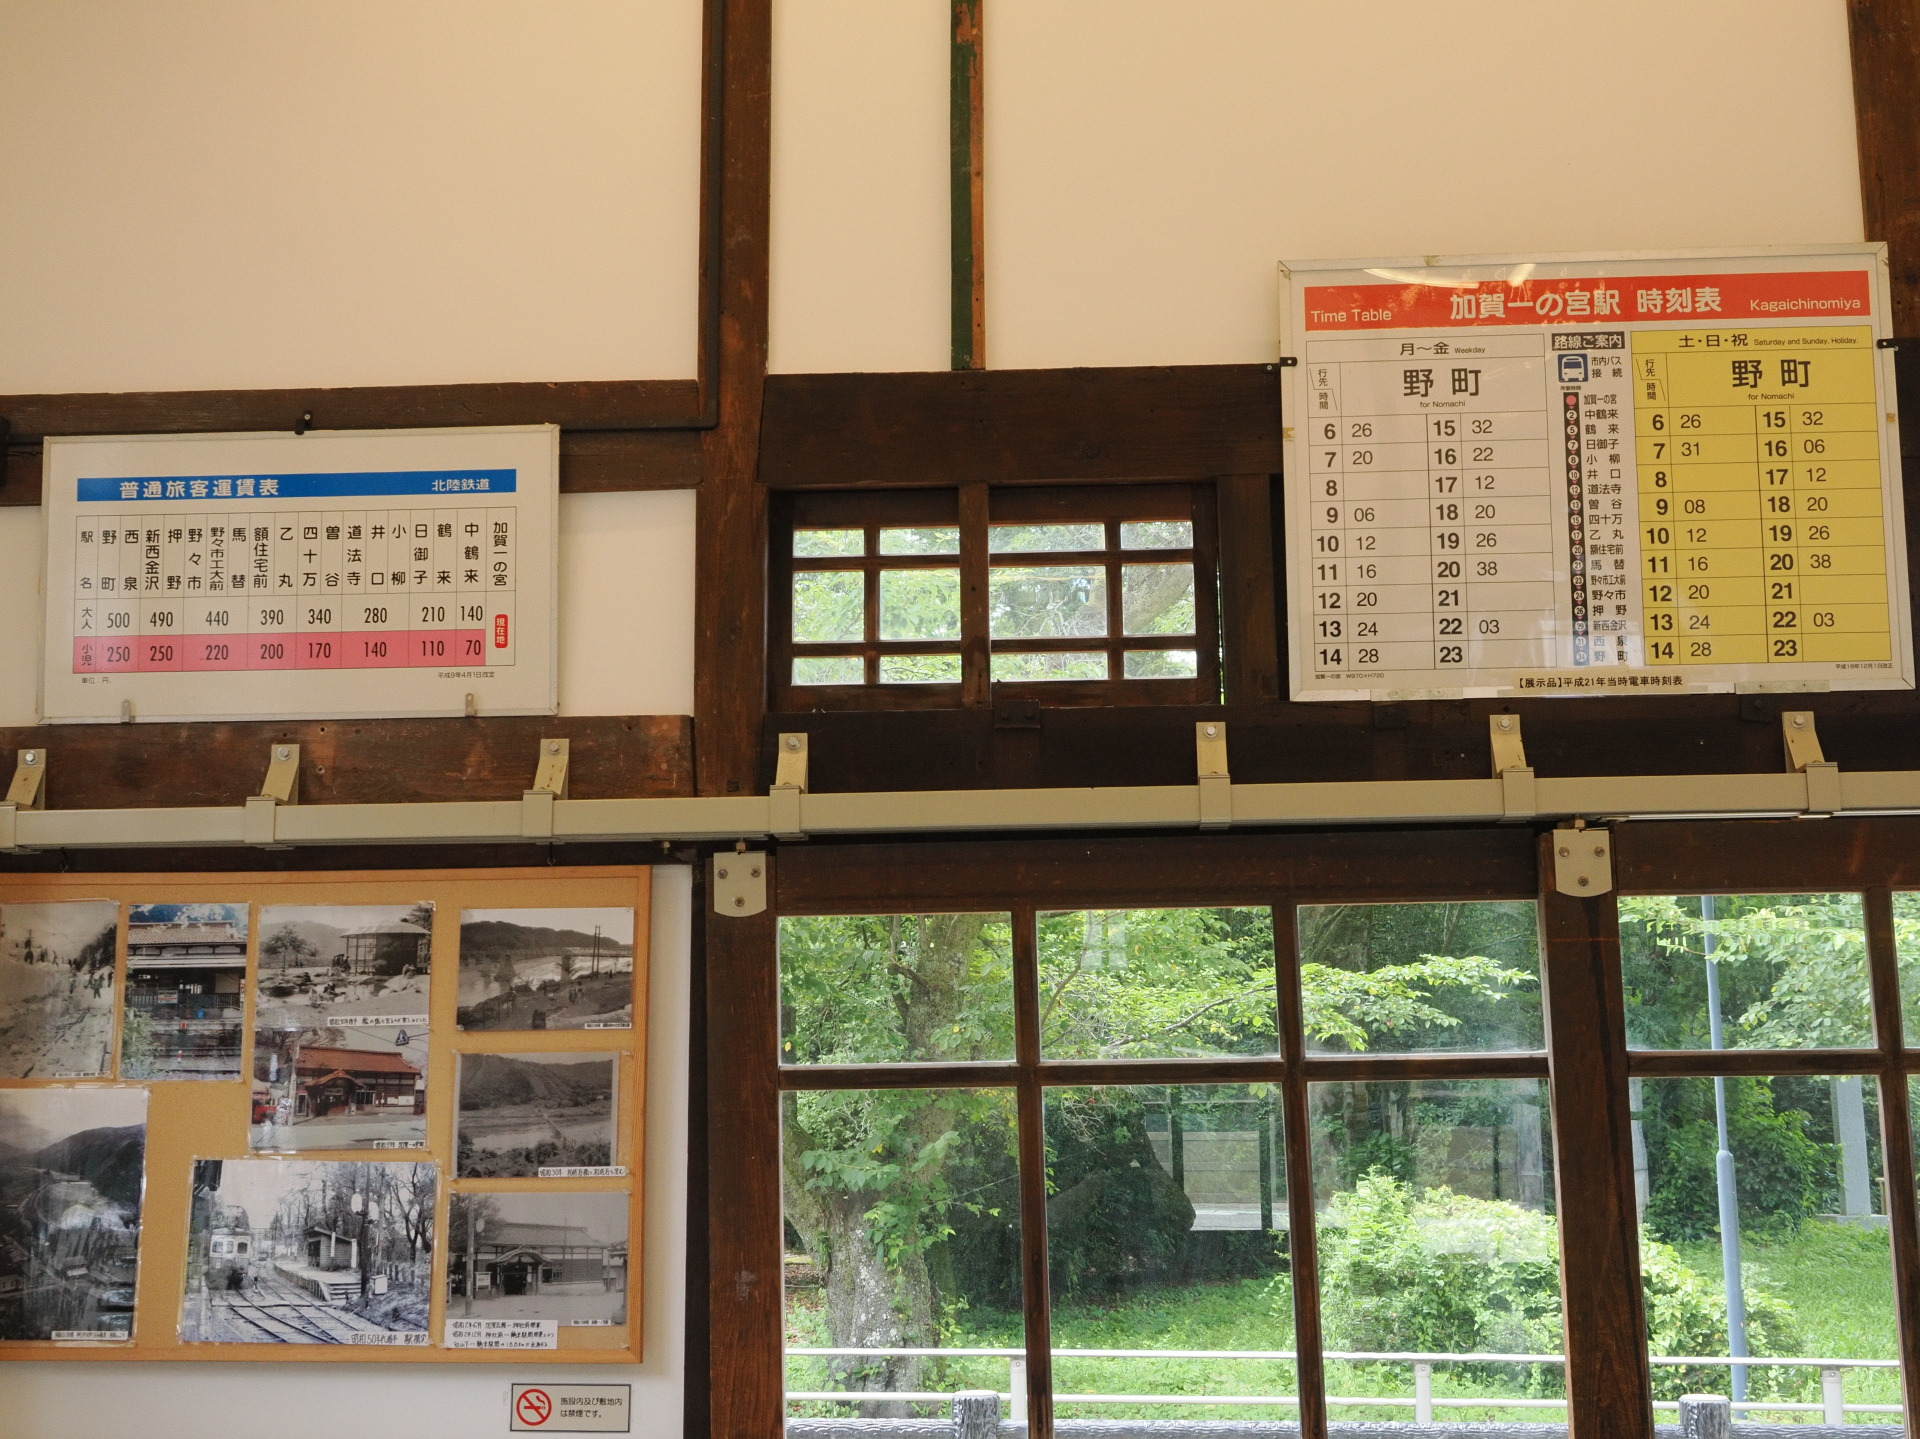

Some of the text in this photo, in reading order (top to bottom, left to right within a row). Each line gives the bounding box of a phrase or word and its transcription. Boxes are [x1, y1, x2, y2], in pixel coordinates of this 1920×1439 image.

[1450, 287, 1721, 320] 加賀一の宮駅 時刻表
[1751, 298, 1860, 312] Kagaichinomiya
[1311, 309, 1391, 322] Time Table
[1554, 334, 1622, 350] 路線ご案内
[1679, 334, 1748, 347] 土・日・祝
[1591, 356, 1621, 366] 市内バス
[1646, 359, 1655, 376] 行先
[1319, 369, 1328, 386] 行先
[1592, 368, 1622, 378] 接続
[1732, 359, 1810, 388] 野町
[1404, 368, 1481, 397] 野町
[1584, 394, 1616, 405] 加賀一の宮
[1647, 383, 1656, 400] 時間
[1319, 392, 1328, 409] 時間
[1585, 409, 1618, 419] 中鶴来
[1653, 414, 1701, 430] 6 26
[1763, 412, 1823, 427] 15 32
[1324, 423, 1372, 439] 6 26
[1434, 420, 1492, 436] 15 32
[1585, 424, 1619, 434] 鶴来
[1587, 439, 1619, 449] 日御子
[1653, 442, 1699, 459] 7 31
[1765, 439, 1825, 456] 16 06
[1325, 451, 1373, 467] 7 20
[1435, 447, 1493, 464] 16 22
[1587, 454, 1620, 465] 小柳
[1587, 469, 1620, 479] 井口
[1656, 472, 1667, 487] 8
[1766, 468, 1826, 485] 17 12
[120, 480, 279, 499] 普通旅客運賃表
[432, 479, 489, 491] 北陸鉄道
[1326, 480, 1337, 496] 8
[1436, 476, 1494, 493] 17 12
[1588, 484, 1621, 494] 道法寺
[1436, 504, 1495, 520] 18 20
[1656, 499, 1705, 515] 9 08
[1768, 496, 1827, 512] 18 20
[1327, 507, 1374, 523] 9 06
[1589, 514, 1622, 524] 四十万
[1437, 533, 1496, 549] 19 26
[1590, 529, 1624, 540] 乙丸
[1647, 528, 1706, 544] 10 12
[1769, 525, 1829, 541] 19 26
[1317, 536, 1375, 552] 10 12
[102, 530, 116, 591] 野町
[124, 530, 139, 590] 西泉
[145, 530, 160, 590] 新西金沢
[167, 529, 182, 589] 押野
[188, 529, 202, 590] 野々市
[210, 527, 225, 590] 野々市工大前
[232, 528, 246, 588] 馬替
[254, 527, 268, 588] 額住宅前
[279, 528, 293, 587] 乙丸
[303, 527, 317, 586] 四十万
[325, 526, 340, 586] 曽谷
[347, 525, 361, 585] 道法寺
[372, 525, 385, 585] 井口
[391, 524, 406, 585] 小柳
[414, 524, 428, 584] 日御子
[437, 523, 451, 584] 鶴来
[465, 523, 478, 583] 中鶴来
[493, 522, 507, 586] 加賀一の宮
[1438, 561, 1497, 577] 20 38
[1648, 557, 1708, 573] 11 16
[1770, 554, 1831, 570] 20 38
[1318, 564, 1376, 580] 11 16
[1439, 590, 1458, 606] 21
[1592, 590, 1626, 600] 野々市
[1649, 585, 1709, 601] 12 20
[1772, 583, 1792, 599] 21
[1319, 592, 1377, 609] 12 20
[82, 607, 92, 629] 大人
[107, 613, 130, 628] 500
[150, 612, 173, 627] 490
[206, 611, 228, 626] 440
[261, 610, 283, 625] 390
[308, 609, 331, 624] 340
[365, 608, 387, 623] 280
[422, 607, 444, 622] 210
[461, 606, 482, 621] 140
[1773, 611, 1834, 628] 22 03
[1319, 621, 1378, 637] 13 24
[1439, 618, 1499, 634] 22 03
[1651, 614, 1710, 630] 13 24
[496, 618, 505, 644] 現在地
[81, 644, 92, 666] 小児
[108, 646, 130, 662] 250
[150, 646, 172, 661] 250
[206, 645, 228, 660] 220
[261, 644, 283, 659] 200
[309, 643, 331, 658] 170
[365, 642, 386, 657] 140
[422, 641, 444, 656] 110
[466, 640, 481, 655] 70
[1440, 646, 1462, 663] 23
[1651, 642, 1711, 658] 14 28
[1774, 640, 1797, 656] 23
[1320, 649, 1378, 665] 14 28
